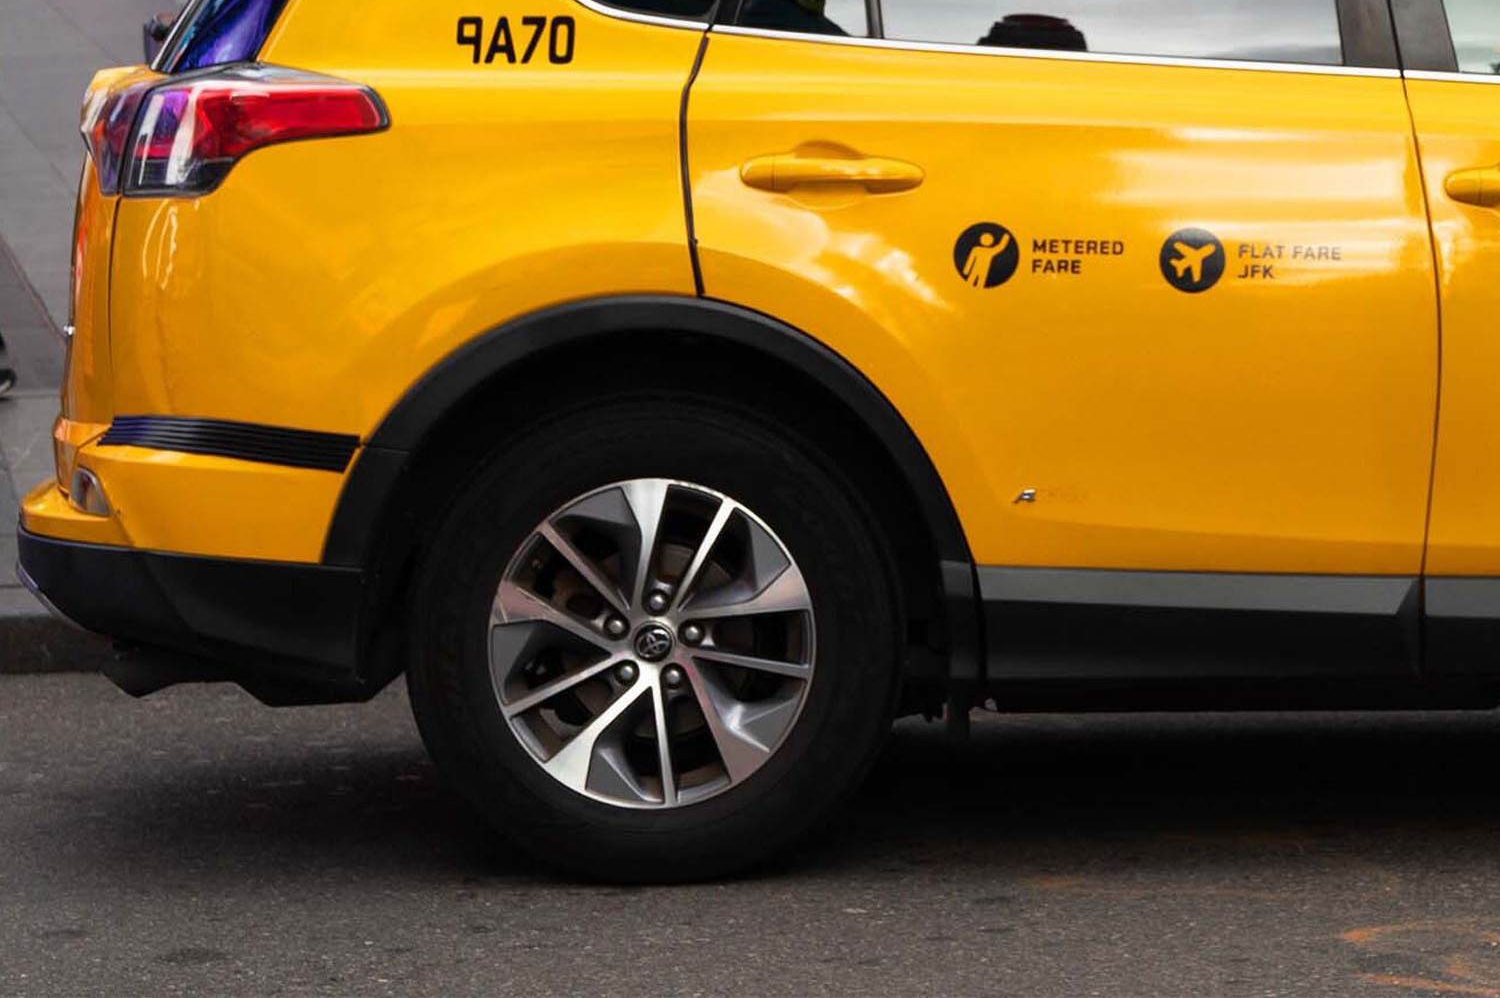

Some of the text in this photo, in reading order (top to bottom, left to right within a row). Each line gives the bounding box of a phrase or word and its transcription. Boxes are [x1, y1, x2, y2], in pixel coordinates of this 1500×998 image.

[456, 15, 576, 65] 9A70
[1032, 239, 1124, 255] METERED
[1238, 244, 1342, 261] FLAT FARE
[1032, 258, 1082, 274] FARE
[1238, 264, 1274, 280] JFK
